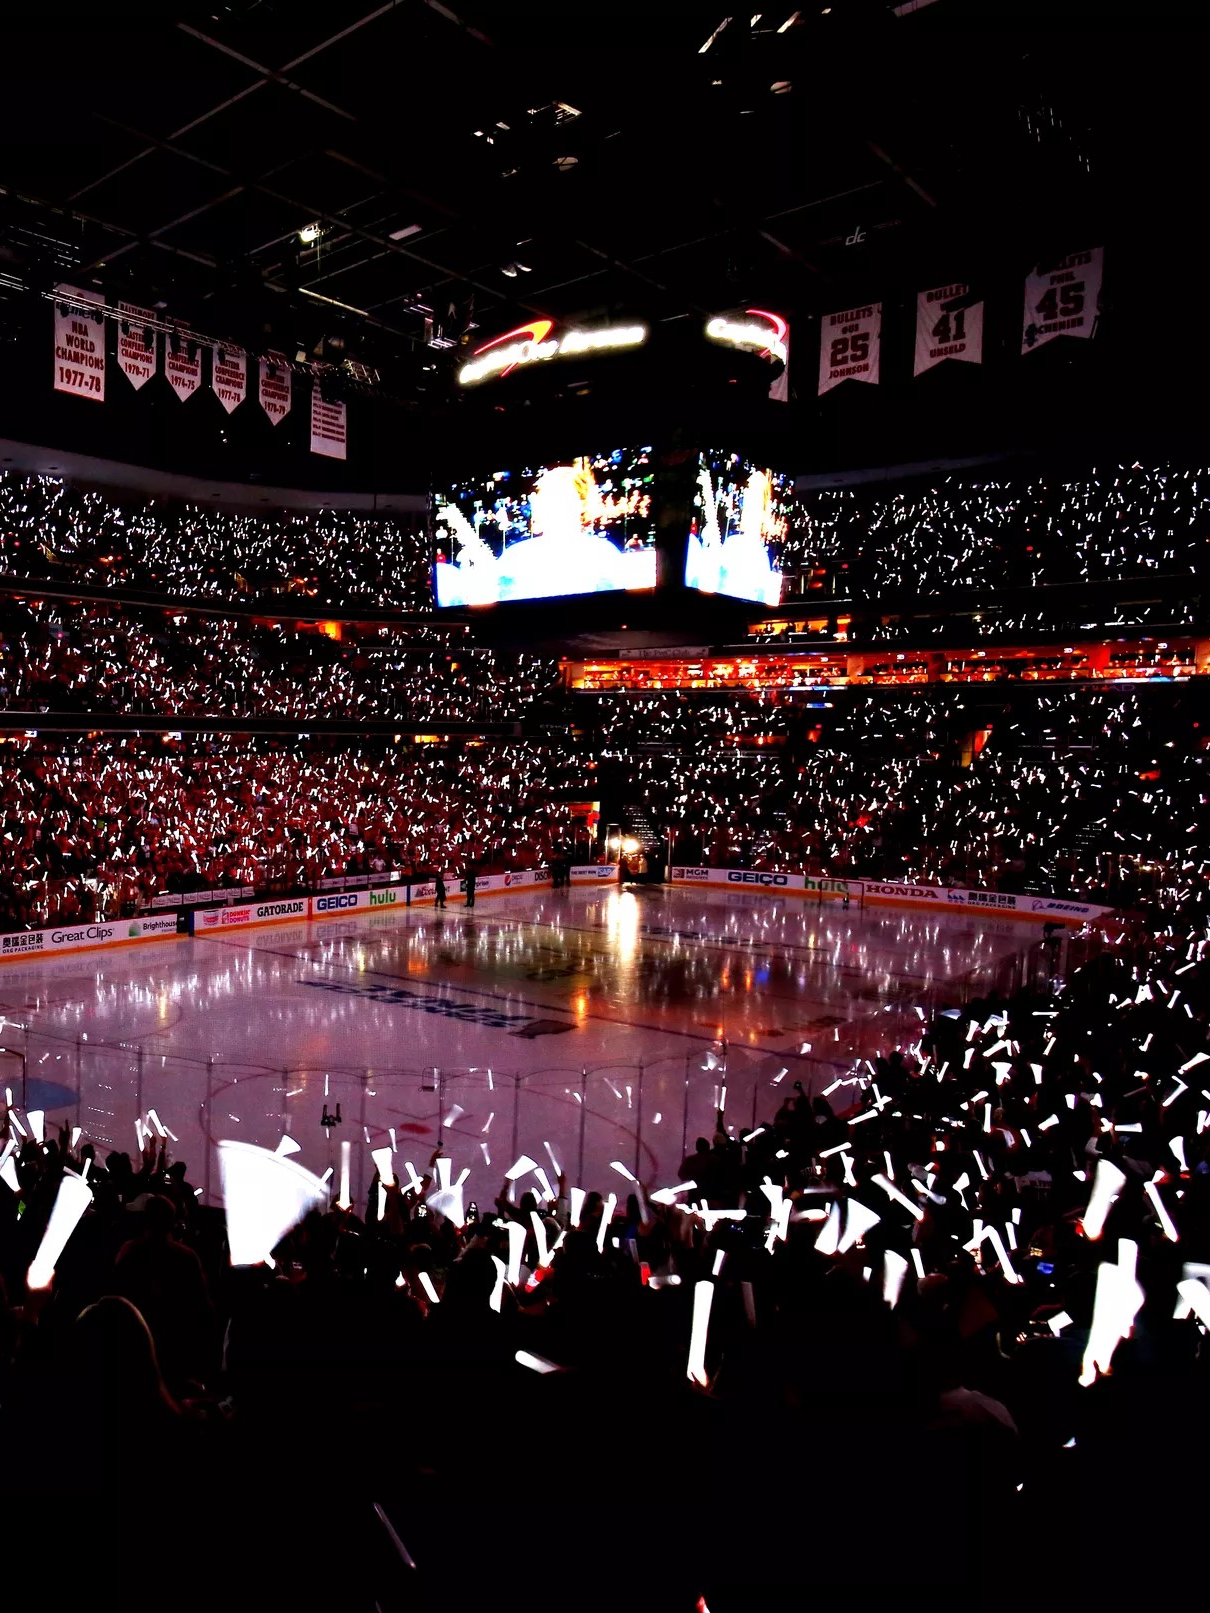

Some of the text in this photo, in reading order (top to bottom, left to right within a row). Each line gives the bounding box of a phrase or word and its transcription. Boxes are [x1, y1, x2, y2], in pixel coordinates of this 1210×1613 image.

[1035, 281, 1085, 321] 45
[829, 306, 873, 326] BULLETS
[71, 320, 89, 337] NBA
[932, 310, 966, 345] 41
[65, 333, 95, 353] WORLD
[120, 337, 154, 355] CONFERECE
[830, 332, 870, 368] 25
[930, 343, 966, 358] UNSELD
[55, 345, 104, 371] CHAMPIONS
[121, 348, 153, 364] CHAMPIONS
[124, 362, 150, 379] 1970-71
[828, 363, 869, 379] JOHNSON
[59, 366, 101, 393] 1977-78
[171, 374, 195, 390] 1974-75
[685, 868, 709, 876] MGM
[727, 871, 788, 886] GEICO
[370, 889, 396, 905] hulu
[866, 884, 939, 899] HONDA
[257, 901, 304, 917] GATORADE
[317, 894, 358, 911] GEICO
[1046, 902, 1090, 913] BOEING
[143, 920, 177, 931] Brighthous
[51, 926, 113, 944] Great Clips
[14, 944, 44, 952] PACKAGING
